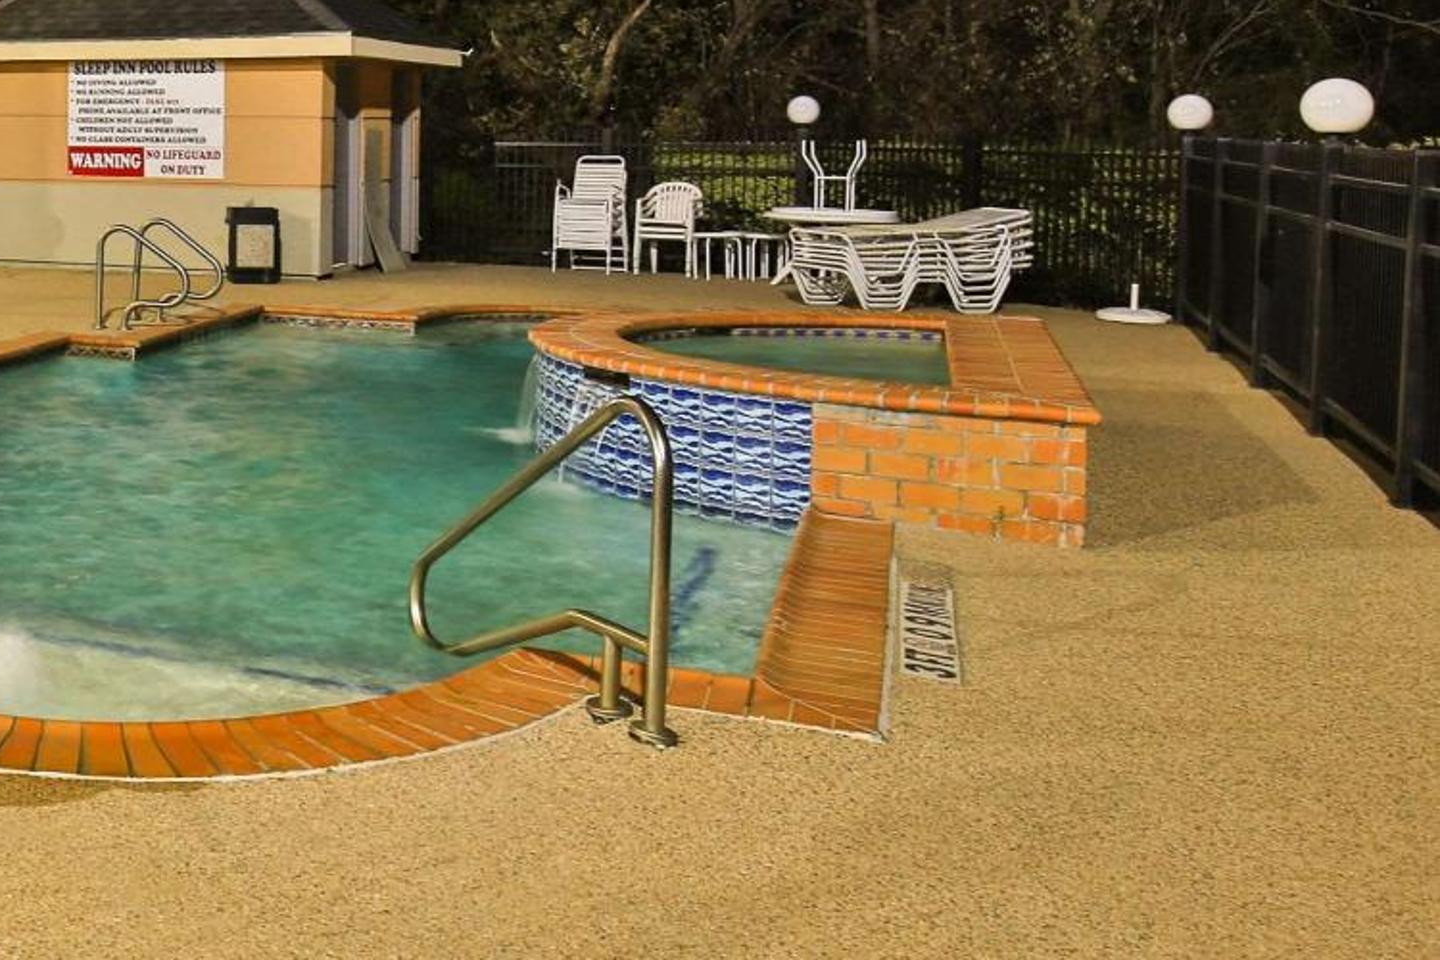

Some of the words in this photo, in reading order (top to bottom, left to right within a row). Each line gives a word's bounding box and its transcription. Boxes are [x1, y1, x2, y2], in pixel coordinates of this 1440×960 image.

[74, 60, 111, 75] SLEEP
[113, 60, 135, 74] INN
[139, 60, 172, 74] POOL
[174, 60, 216, 74] RULES
[192, 107, 221, 115] OFFICE
[167, 136, 207, 144] ALLOWED
[145, 149, 160, 160] NO
[163, 149, 221, 160] LIFEGUARD
[70, 153, 142, 170] WARNING
[161, 165, 175, 175] ON
[177, 165, 205, 176] DUTY
